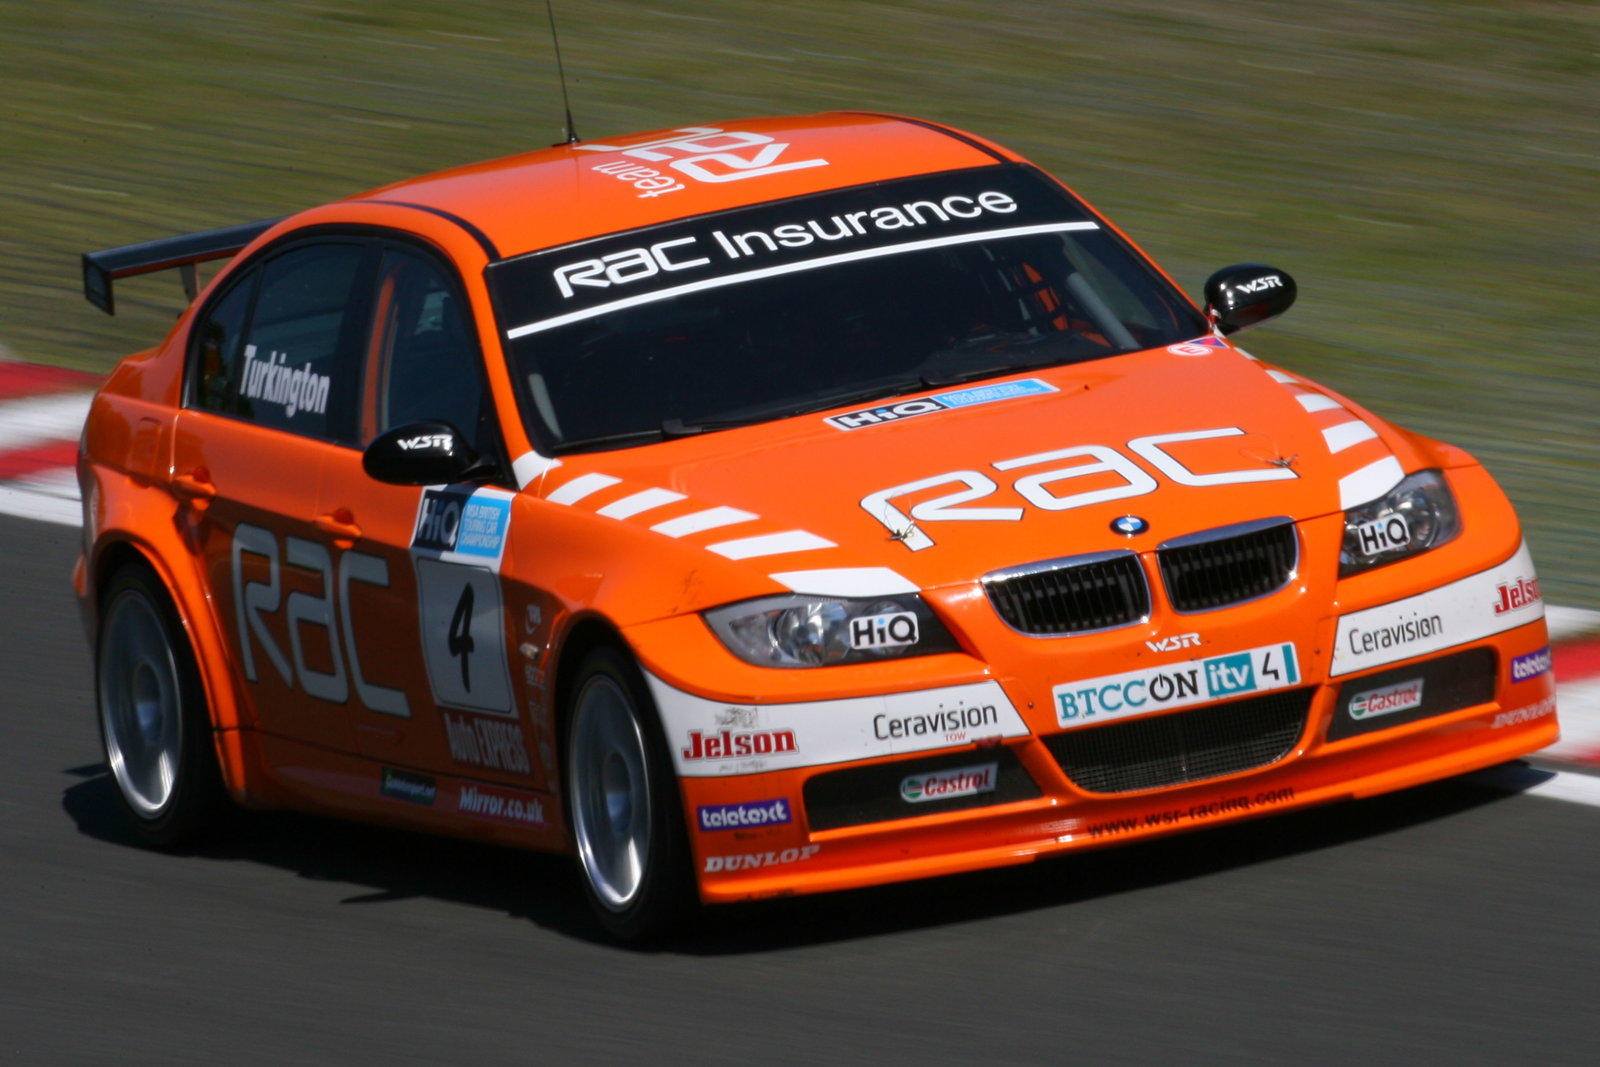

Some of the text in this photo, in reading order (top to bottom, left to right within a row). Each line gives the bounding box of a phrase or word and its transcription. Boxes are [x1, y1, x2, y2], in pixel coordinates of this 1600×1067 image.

[591, 161, 686, 198] team
[712, 191, 1018, 258] Insurance
[1235, 275, 1284, 294] WSR
[240, 344, 331, 418] Turkington
[836, 399, 945, 430] HiQ
[397, 433, 453, 452] WSR
[418, 499, 461, 547] HiQ
[1360, 518, 1408, 553] HiQ
[448, 582, 475, 693] 4
[852, 613, 918, 647] HiQ
[1145, 631, 1202, 653] WSR
[1349, 611, 1444, 656] Ceravision
[1207, 661, 1250, 692] itv
[1261, 651, 1280, 681] 4
[1367, 683, 1419, 713] Castrol
[872, 701, 999, 742] Ceravision
[944, 732, 967, 743] TOW
[684, 728, 799, 760] Jelson
[923, 767, 991, 797] Castrol
[459, 784, 544, 823] Mirror.co.uk
[701, 800, 788, 828] teletext
[703, 844, 821, 872] DUNLOP
